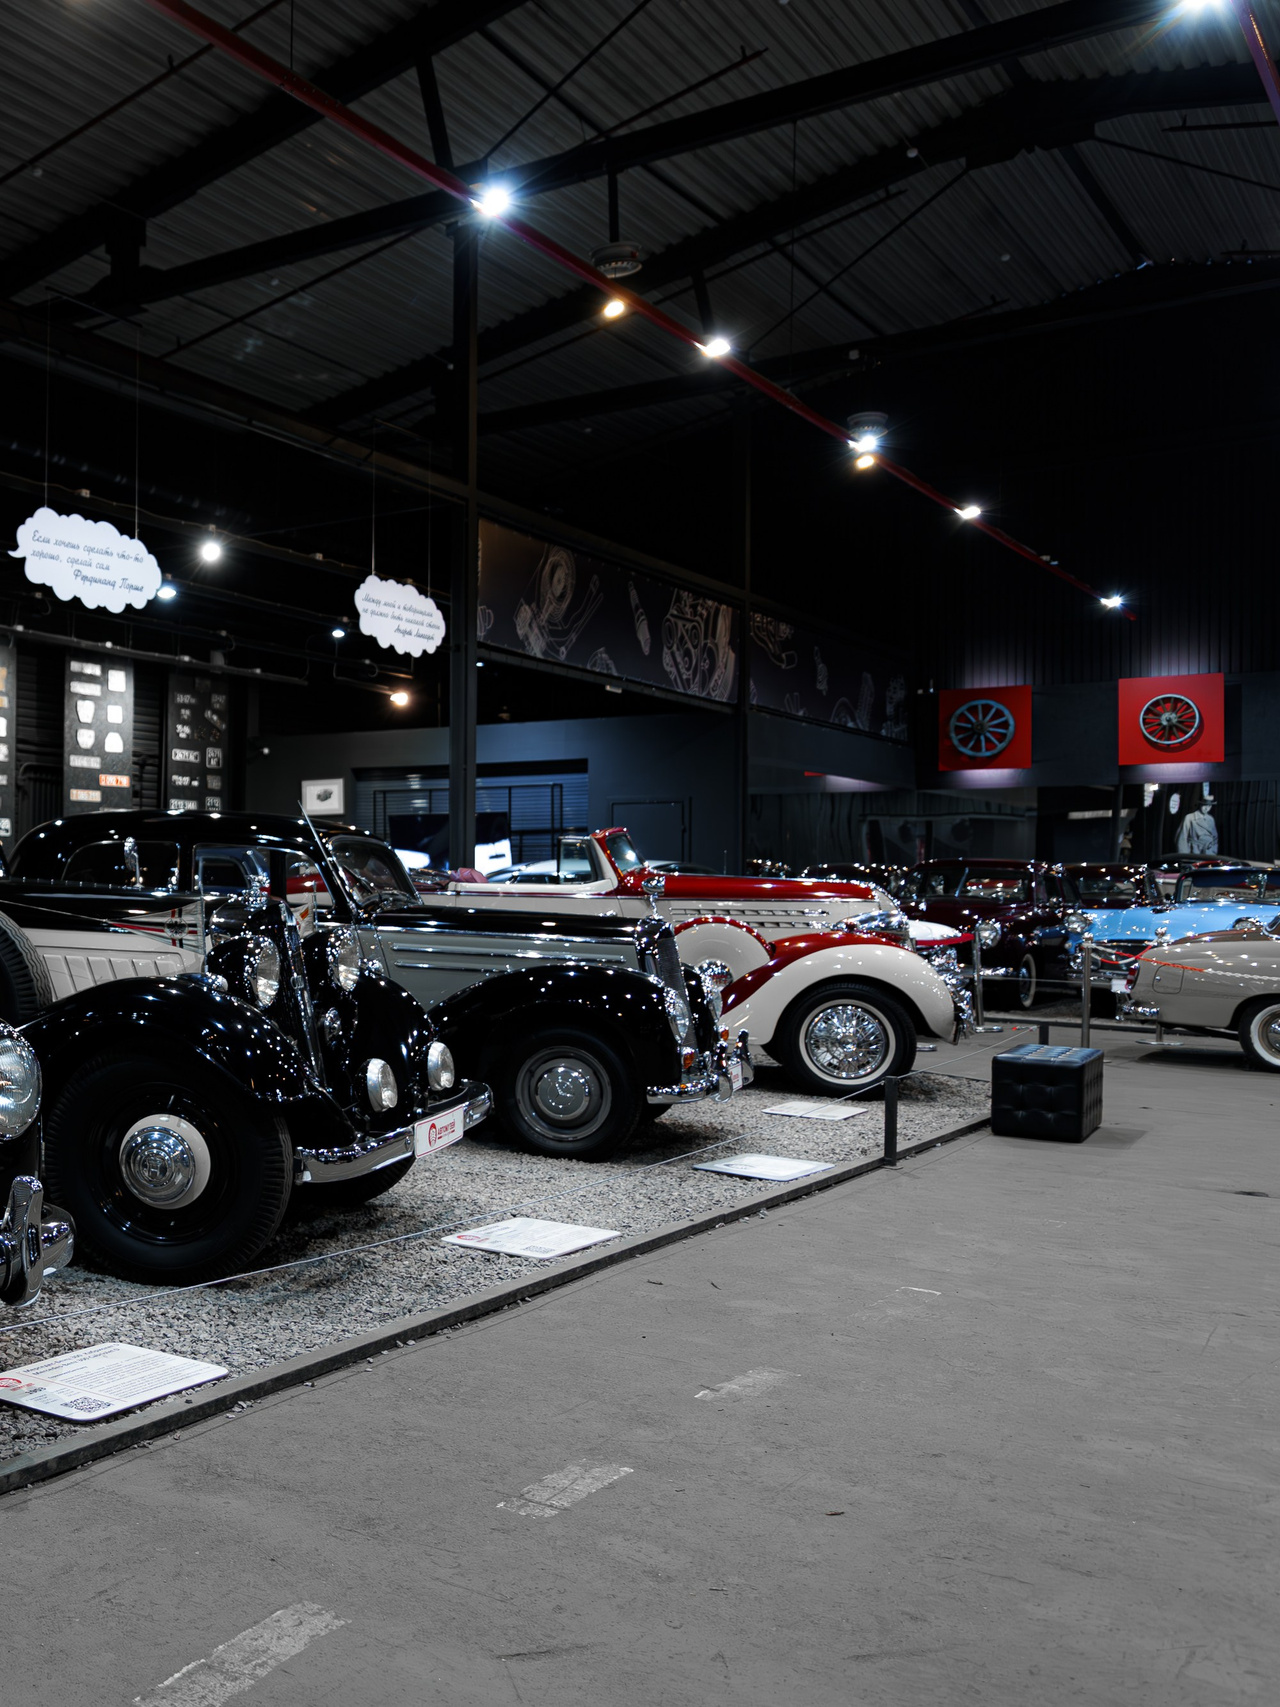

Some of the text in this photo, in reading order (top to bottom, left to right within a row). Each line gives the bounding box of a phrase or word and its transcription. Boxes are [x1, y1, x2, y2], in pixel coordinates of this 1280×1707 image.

[32, 530, 144, 564] Если хочешь сделать что-то
[66, 556, 92, 569] сделай
[95, 563, 110, 571] сам
[73, 568, 144, 593] Фердинанд Порше
